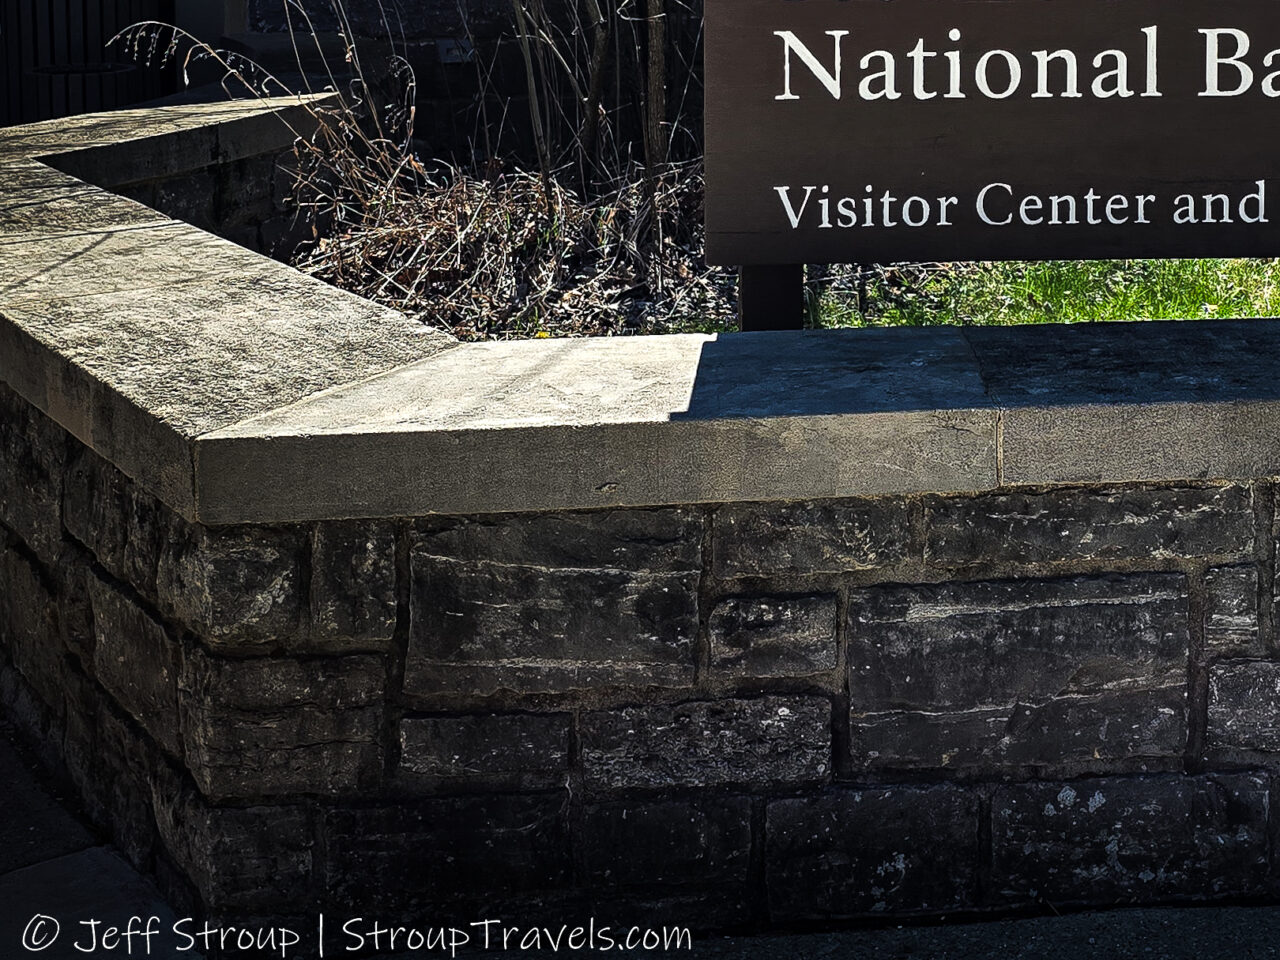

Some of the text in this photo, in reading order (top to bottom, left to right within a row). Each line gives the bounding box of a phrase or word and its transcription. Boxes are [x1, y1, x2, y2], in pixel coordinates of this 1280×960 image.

[773, 25, 1163, 101] National
[773, 184, 958, 229] Visitor
[975, 183, 1156, 226] Center
[1173, 180, 1269, 224] and
